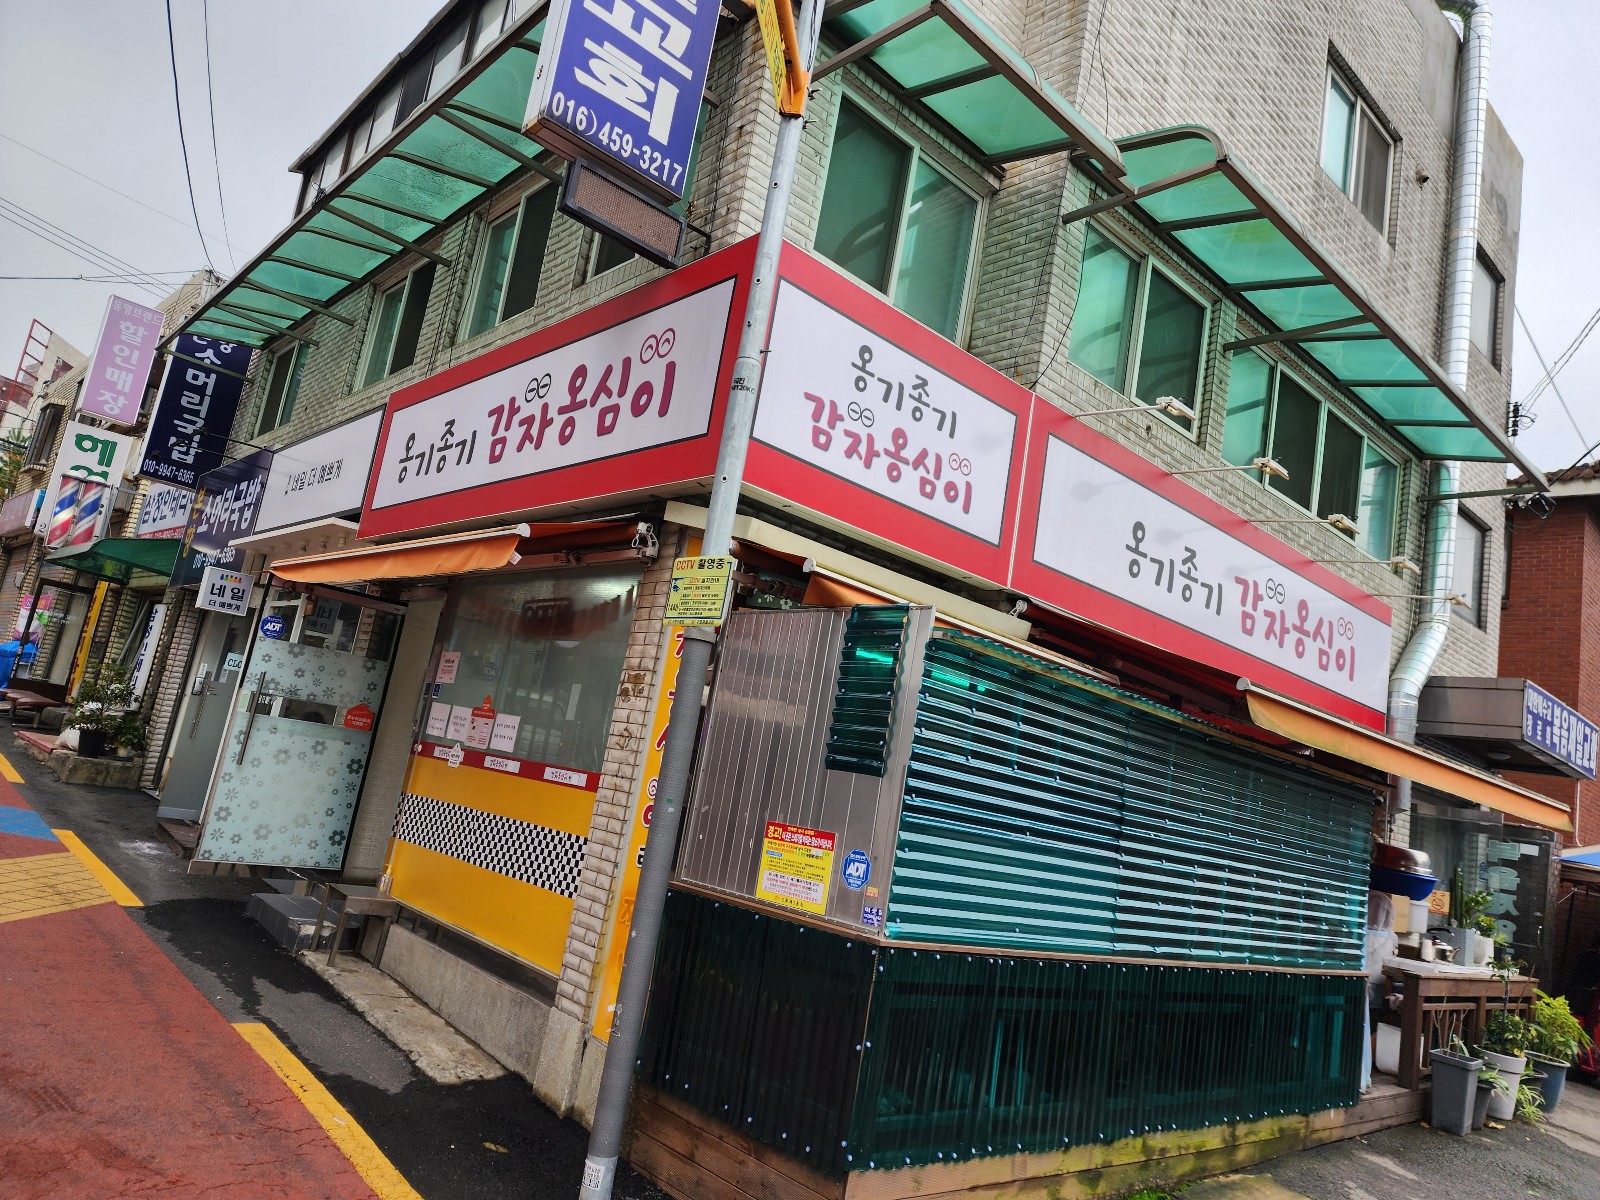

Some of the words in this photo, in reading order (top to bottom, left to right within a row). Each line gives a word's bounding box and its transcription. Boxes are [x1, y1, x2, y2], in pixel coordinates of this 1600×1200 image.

[551, 91, 683, 188] 016)459-3217
[112, 300, 162, 326] 유명브랜드
[96, 320, 149, 415] 할인매장
[851, 344, 957, 440] 옹기종기
[398, 418, 478, 484] 옹기종기
[487, 356, 677, 465] 감자옹심이
[143, 458, 195, 484] 010-9947-6365
[803, 391, 973, 515] 감자옹심이
[142, 488, 194, 525] 삼정인테리
[196, 474, 263, 536] 소머리국밥
[676, 560, 696, 571] CCTV
[698, 558, 725, 570] 촬영중
[208, 599, 216, 607] 더
[209, 582, 245, 602] 네일
[1125, 520, 1223, 616] 옹기종기
[1234, 575, 1356, 682] 감자옹심이
[263, 622, 283, 632] ADT
[846, 861, 867, 878] ADT
